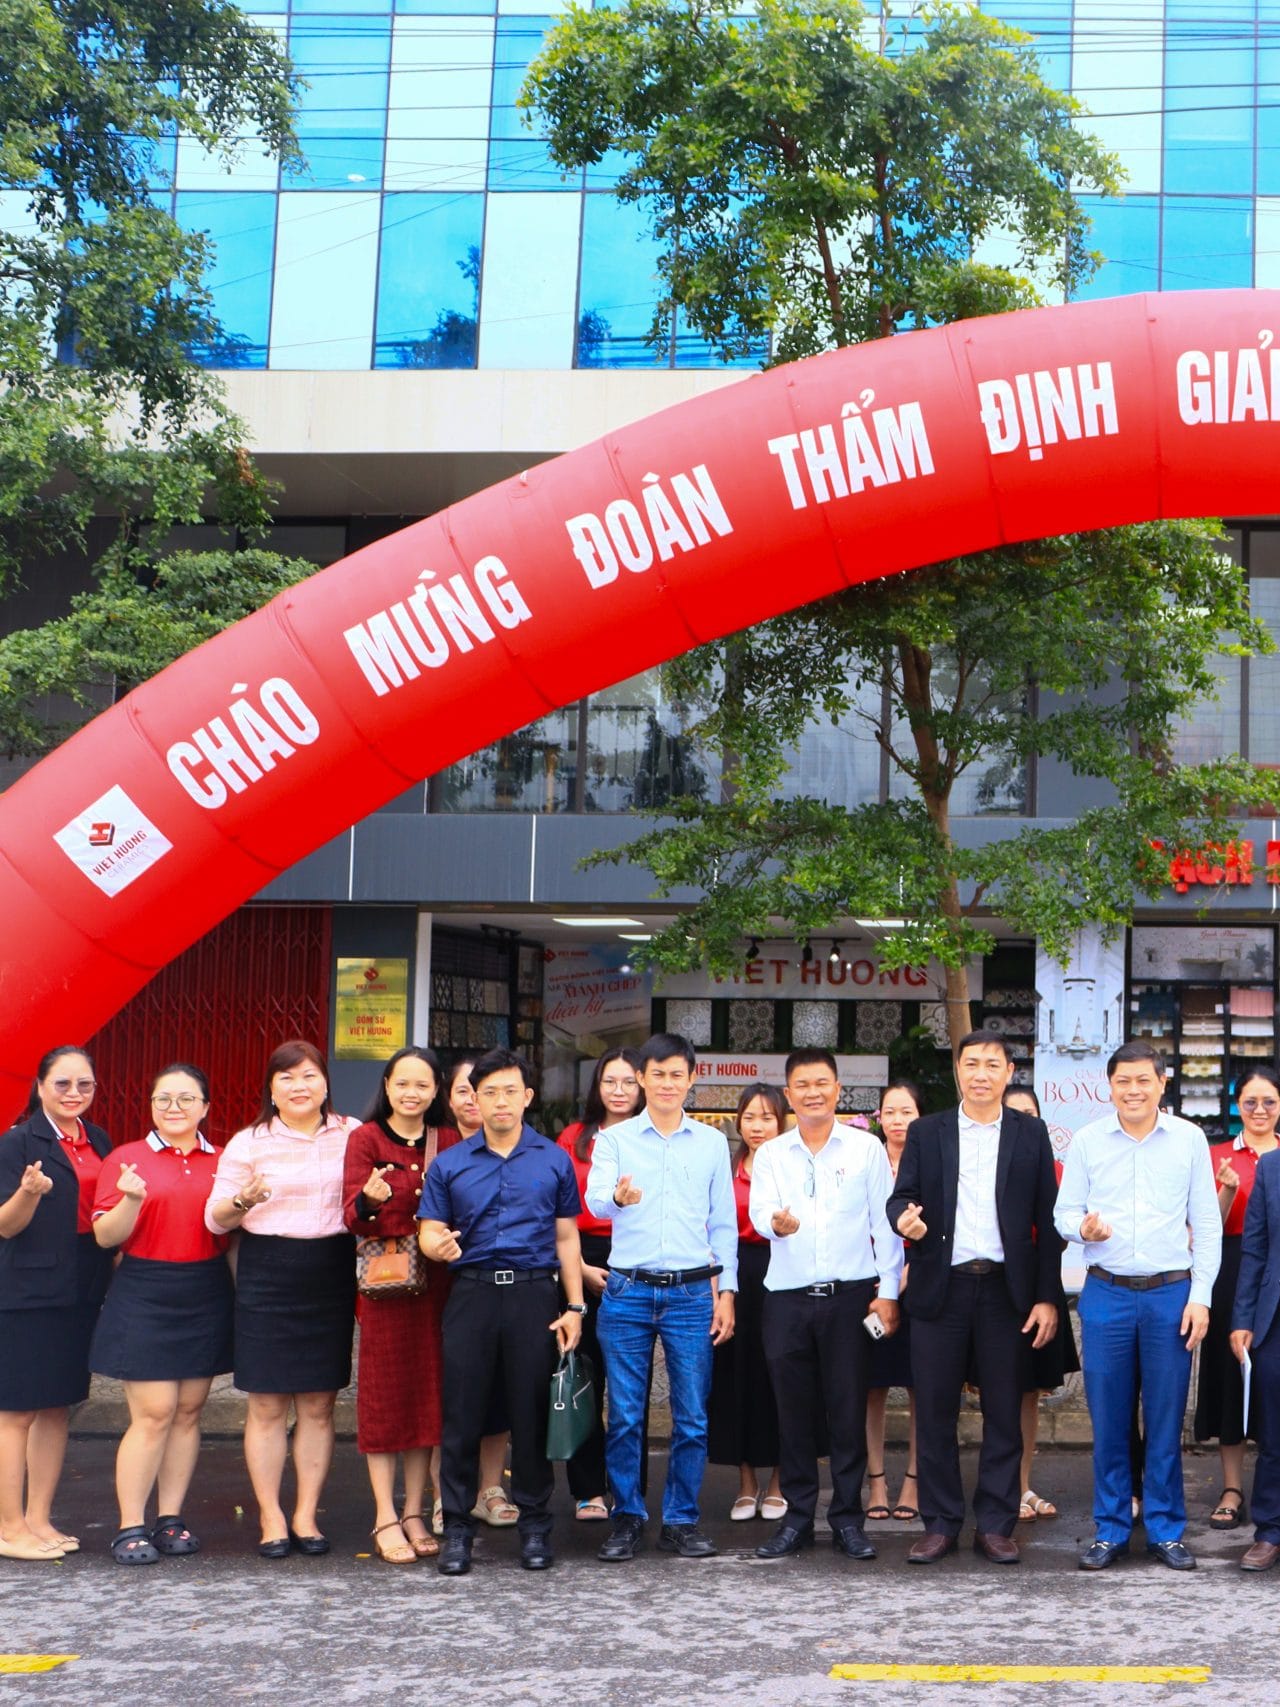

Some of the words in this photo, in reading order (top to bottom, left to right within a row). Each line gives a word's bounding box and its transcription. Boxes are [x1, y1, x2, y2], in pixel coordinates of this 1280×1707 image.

[166, 677, 320, 809] CHÀO
[342, 554, 532, 697] MỪNG
[565, 464, 733, 589] ĐOÀN
[768, 388, 935, 510] THẨM
[979, 361, 1119, 461] ĐỊNH
[93, 856, 115, 876] VIET
[113, 830, 148, 859] HUONG
[1150, 839, 1254, 894] ẠCH
[695, 1060, 713, 1078] IỆT
[717, 1062, 757, 1077] HƯƠNG
[1043, 1077, 1113, 1104] BÔNG
